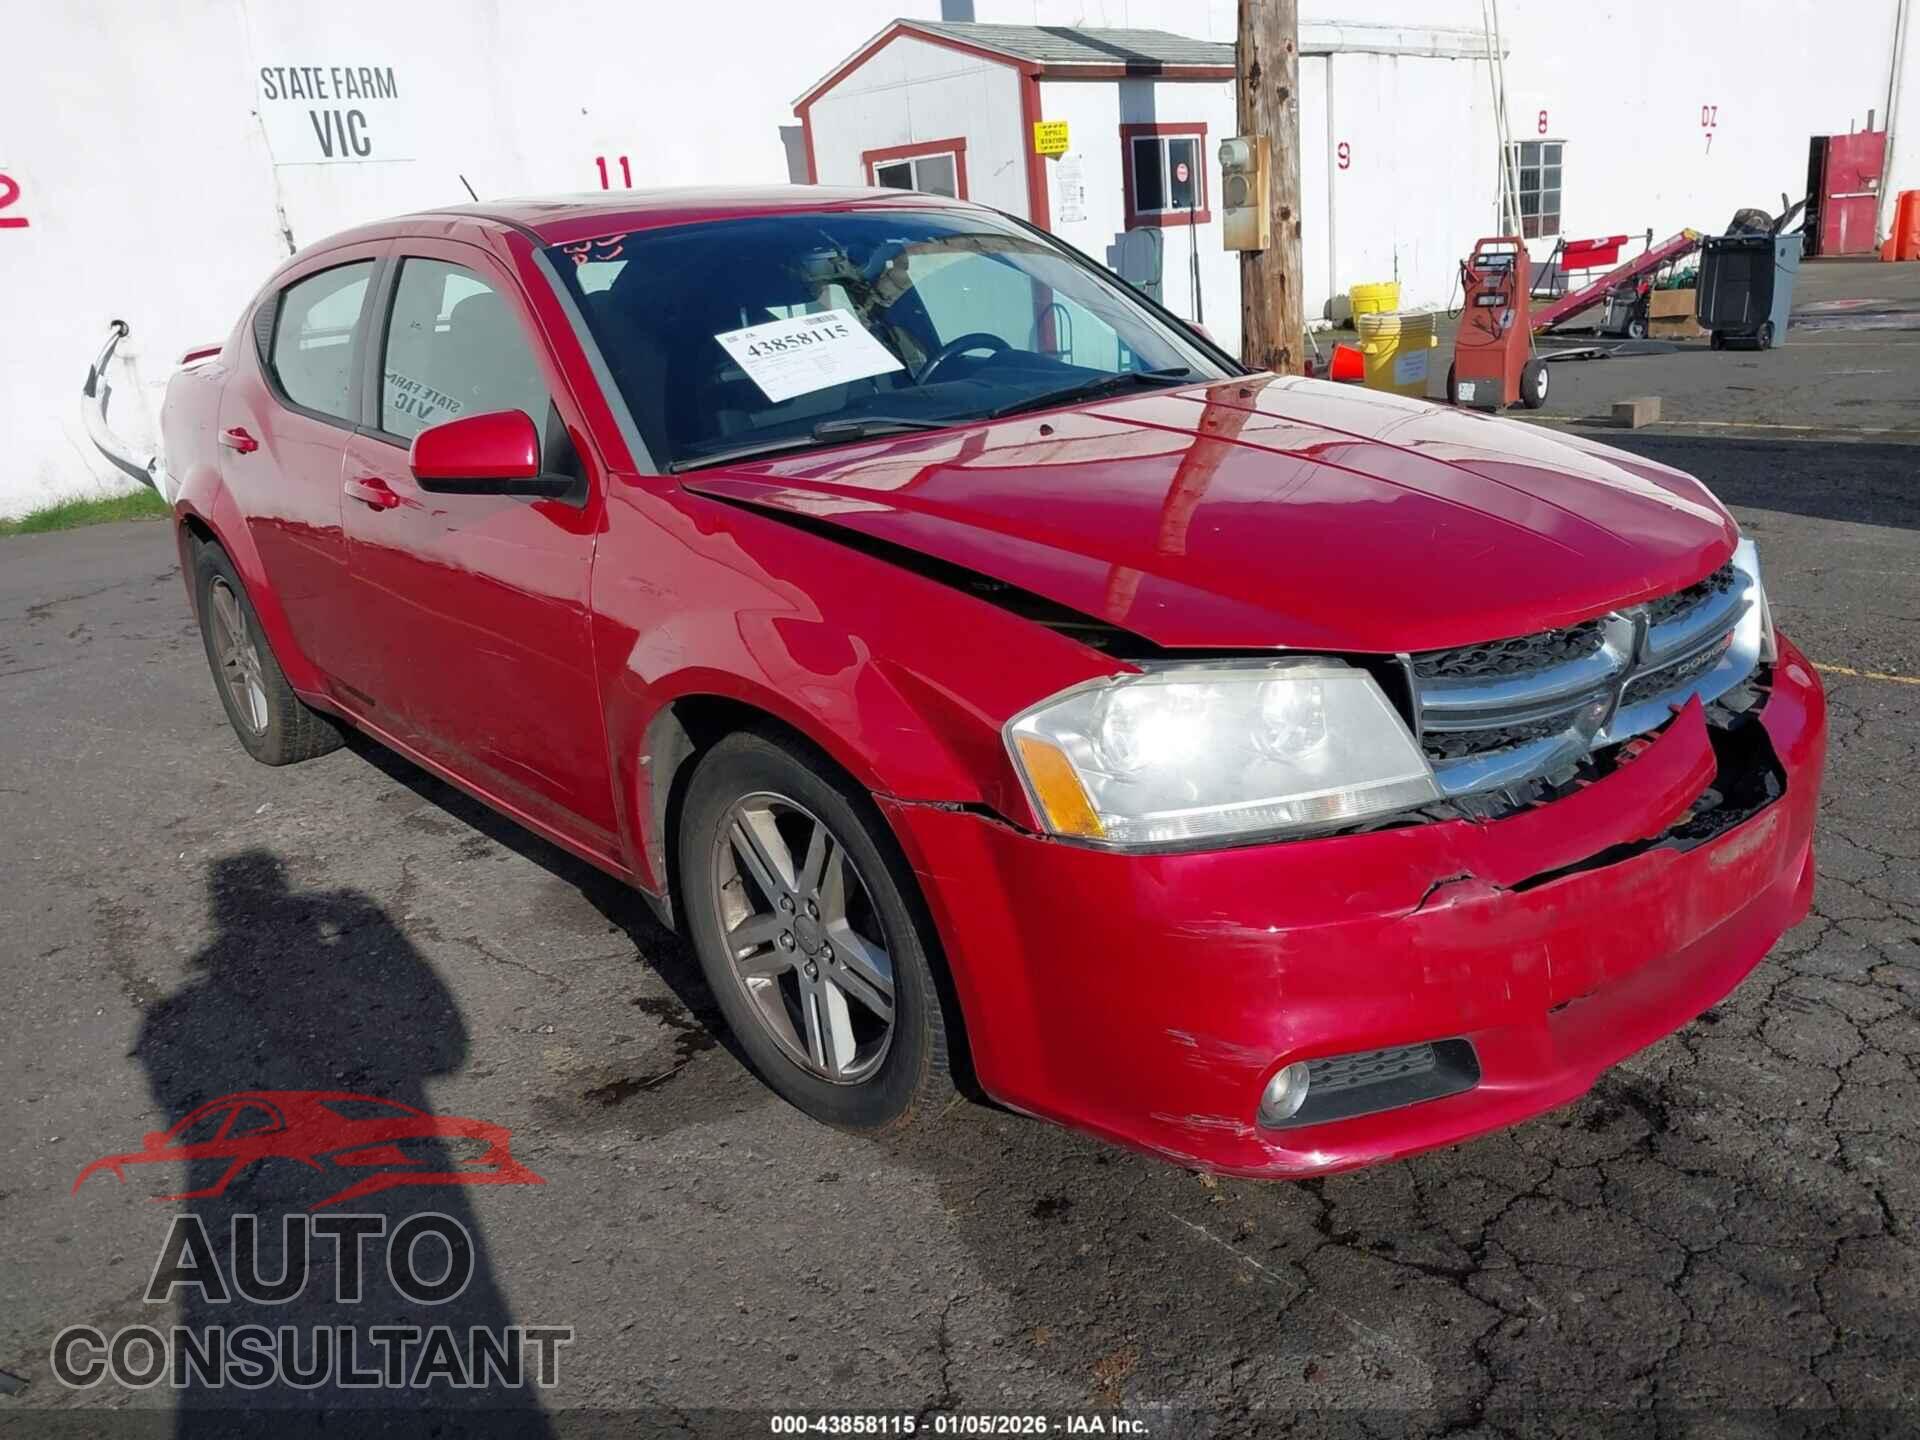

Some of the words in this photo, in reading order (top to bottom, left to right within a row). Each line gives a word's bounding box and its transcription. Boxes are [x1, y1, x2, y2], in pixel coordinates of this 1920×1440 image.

[260, 67, 328, 100] STATE
[330, 67, 398, 99] FARM
[309, 109, 371, 158] VIC
[1044, 129, 1064, 137] SPILL
[1538, 110, 1547, 134] 8
[1040, 137, 1067, 145] STATION
[1338, 142, 1350, 169] 9
[596, 156, 632, 190] 11
[748, 324, 849, 358] 43858115
